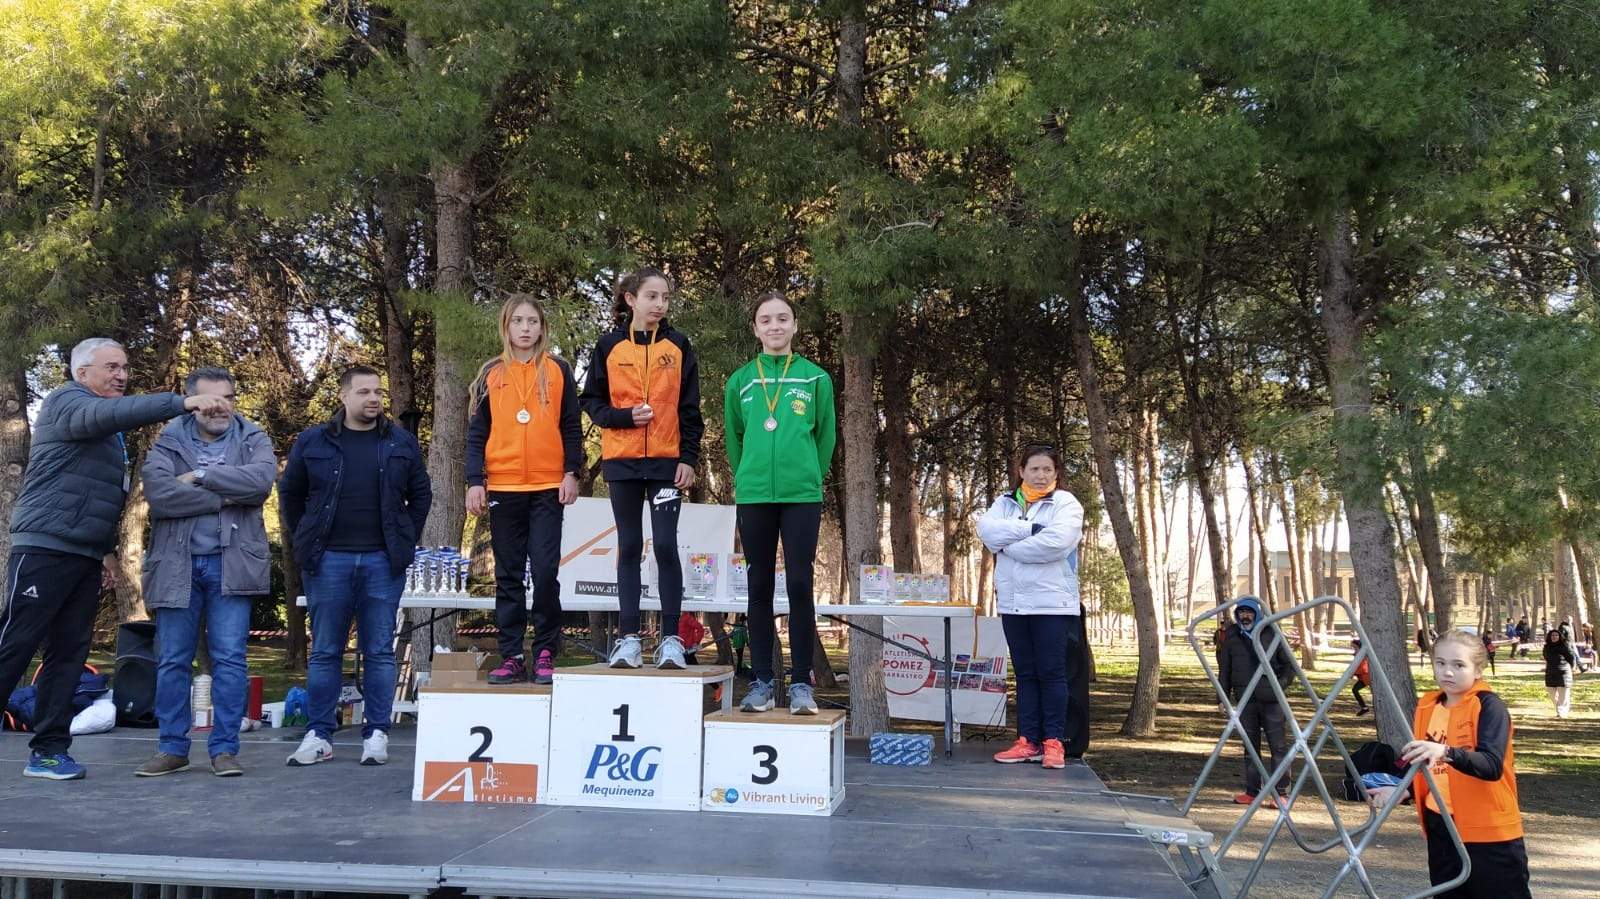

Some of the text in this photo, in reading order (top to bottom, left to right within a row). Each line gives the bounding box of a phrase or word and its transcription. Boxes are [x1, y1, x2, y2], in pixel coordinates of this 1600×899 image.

[658, 488, 679, 497] NIKE
[611, 703, 636, 742] 1
[468, 725, 494, 763] 2
[584, 744, 662, 782] P&G
[751, 744, 779, 785] 3
[582, 783, 655, 798] Mequinenza
[742, 791, 786, 803] Vibrant
[790, 793, 825, 806] Living
